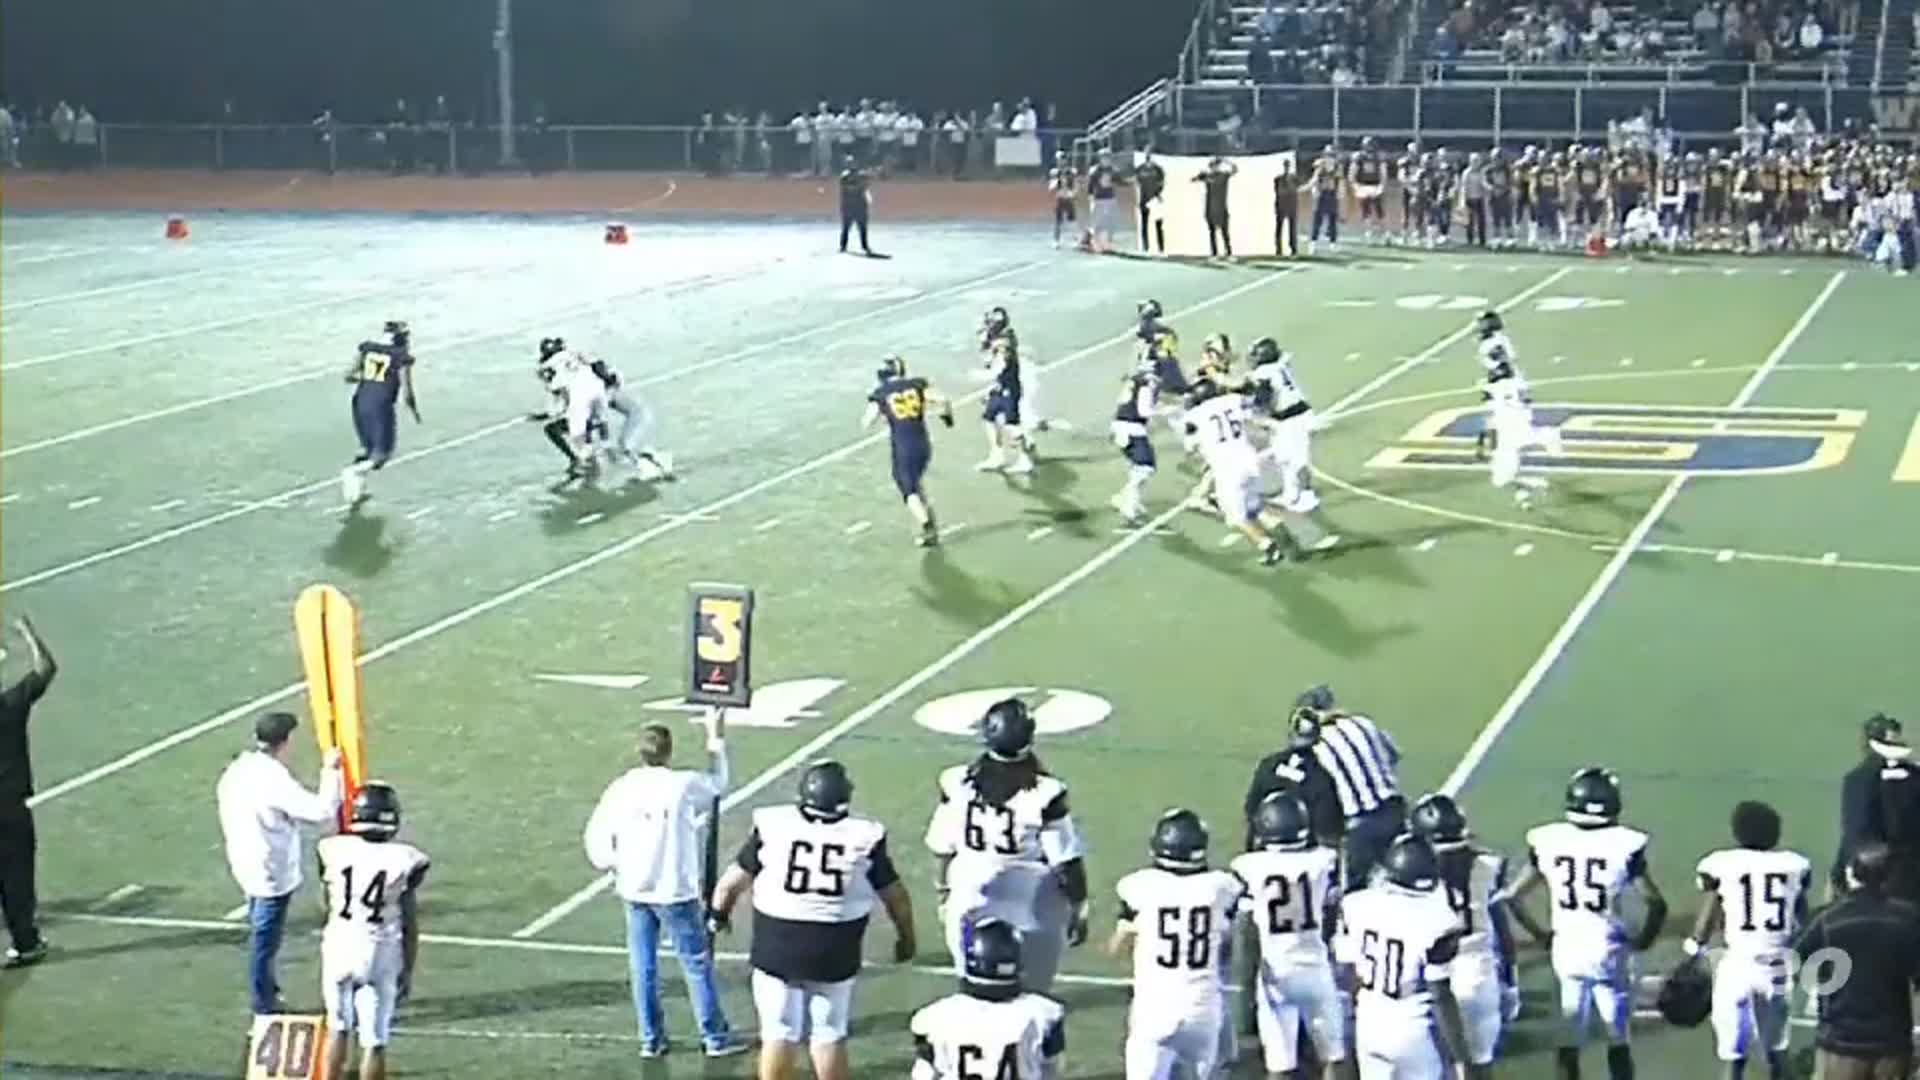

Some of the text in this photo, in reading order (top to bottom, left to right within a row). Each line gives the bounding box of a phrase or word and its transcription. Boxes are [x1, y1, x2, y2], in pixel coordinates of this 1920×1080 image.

[697, 598, 744, 663] 3
[964, 799, 1020, 855] 63
[338, 864, 388, 924] 14
[783, 839, 845, 897] 65
[1554, 855, 1608, 913] 35
[1264, 871, 1319, 934] 21
[1739, 872, 1789, 932] 15
[1156, 904, 1211, 971] 58
[1361, 929, 1405, 999] 50
[254, 1020, 316, 1079] 40
